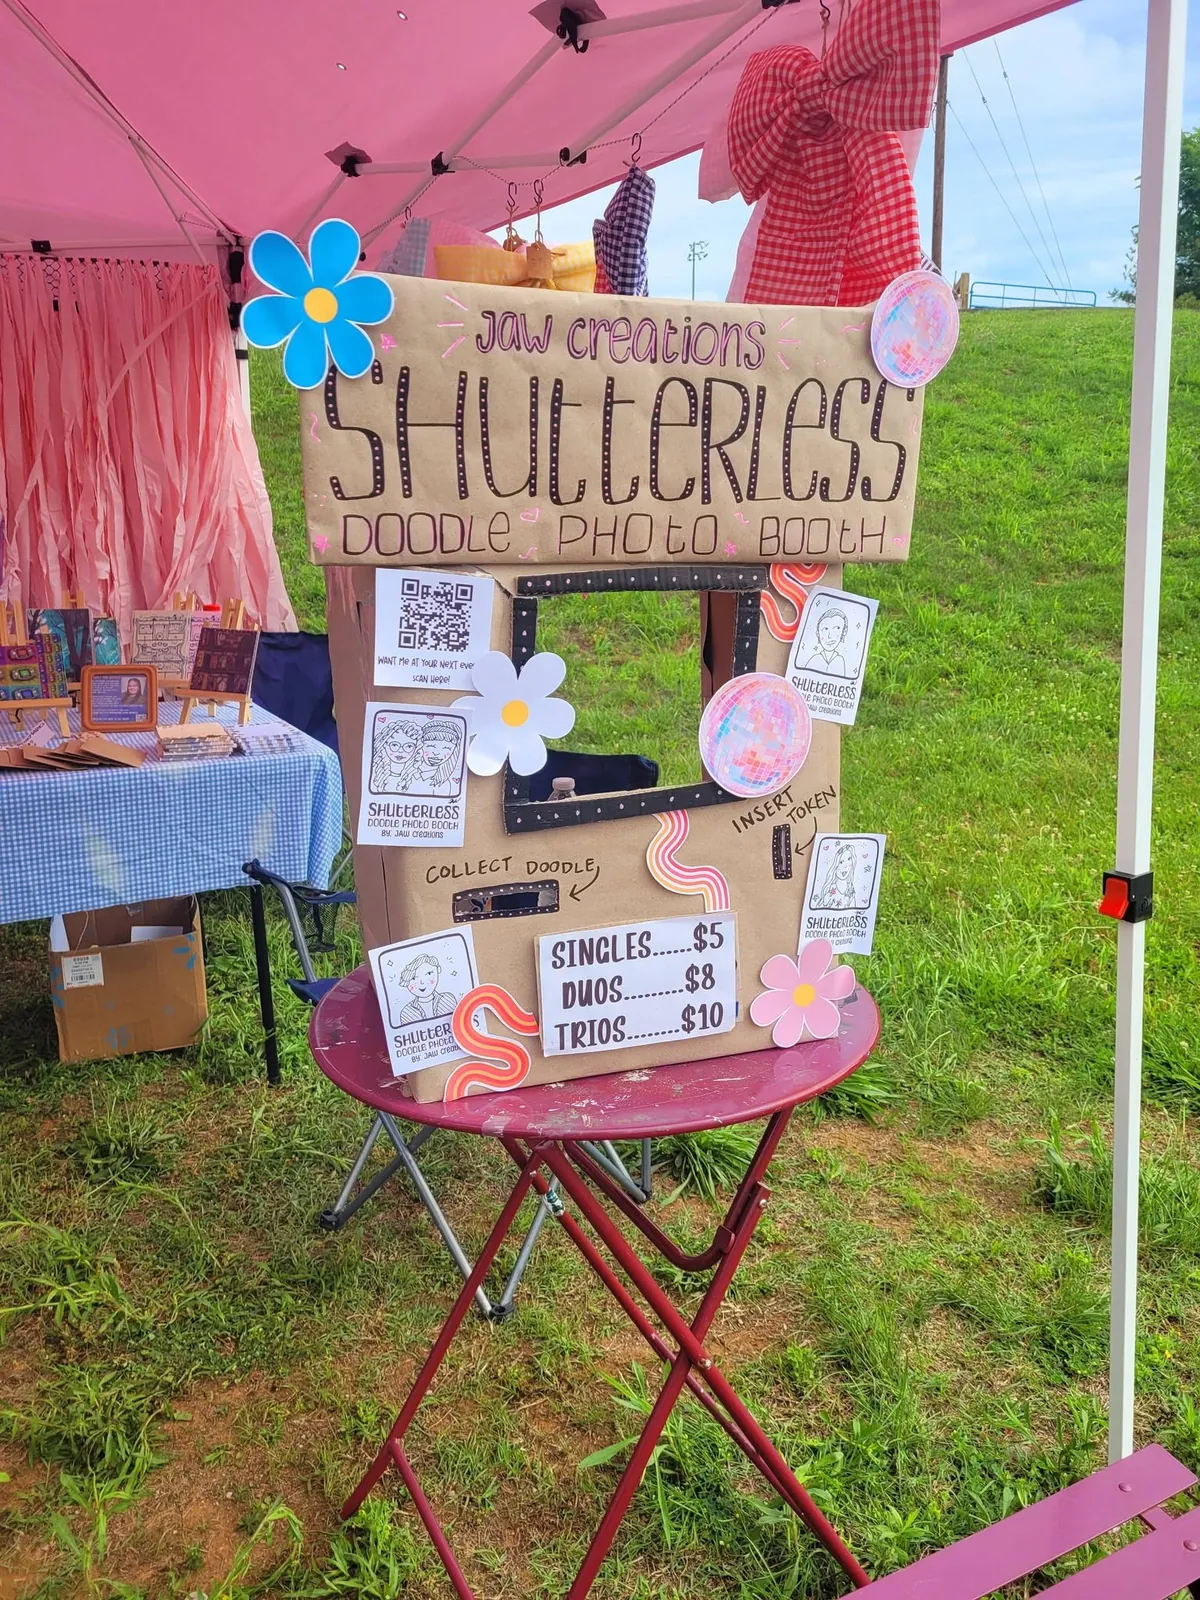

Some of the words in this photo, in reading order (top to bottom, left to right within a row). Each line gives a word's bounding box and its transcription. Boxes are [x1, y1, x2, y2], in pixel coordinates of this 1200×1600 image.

[567, 316, 766, 370] creations
[343, 511, 510, 557] DOODLe
[378, 656, 397, 666] WANT
[411, 657, 420, 667] AT
[413, 674, 428, 684] SCAN
[732, 785, 794, 833] INSERT
[786, 785, 836, 824] TOKEN
[412, 830, 444, 839] creations
[426, 856, 512, 884] COLLECT
[526, 858, 595, 876] DOODLE
